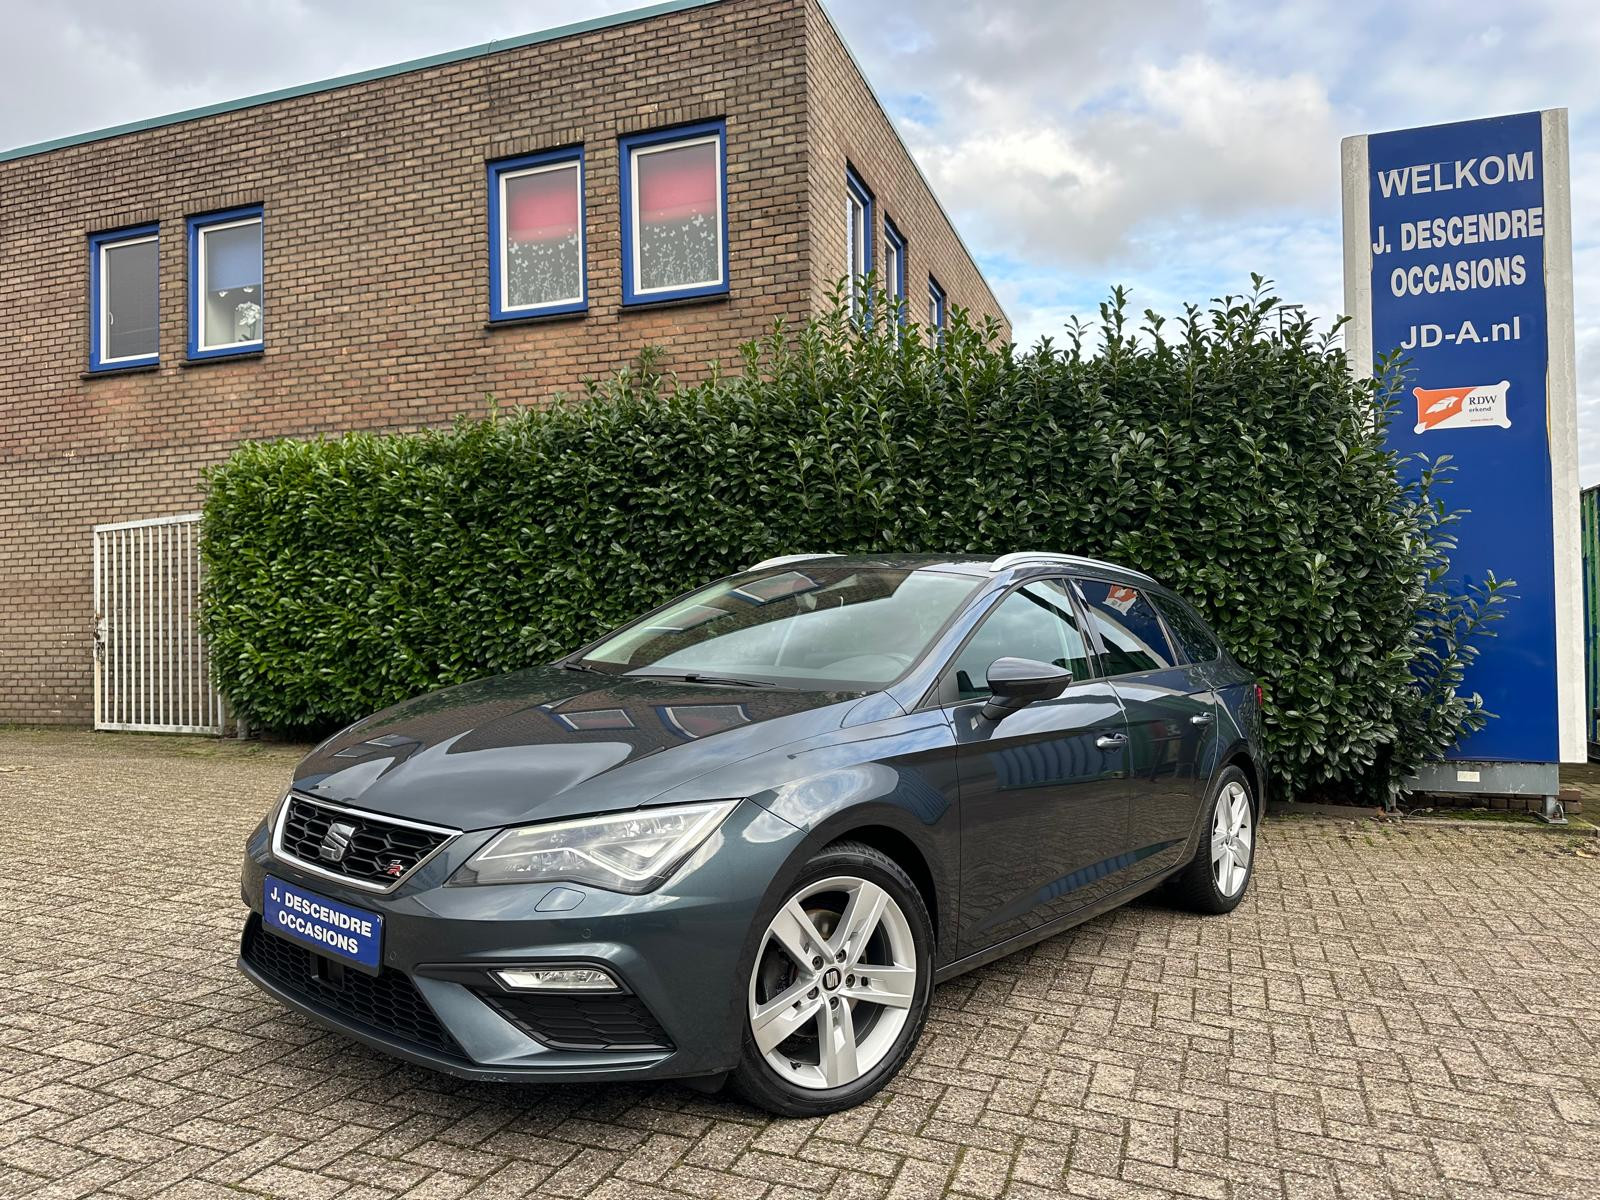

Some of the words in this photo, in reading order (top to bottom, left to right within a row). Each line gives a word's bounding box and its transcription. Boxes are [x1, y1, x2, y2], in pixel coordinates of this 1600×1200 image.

[1378, 151, 1533, 198] WELKOM
[1372, 226, 1391, 255] J.
[1401, 207, 1544, 252] DESCENDRE
[1391, 255, 1526, 297] OCCASIONS
[1400, 316, 1520, 350] JD-A.nl
[1469, 395, 1497, 405] RDW
[270, 886, 281, 903] J.
[285, 893, 372, 938] DESCENDRE
[278, 910, 359, 954] OCCASIONS
